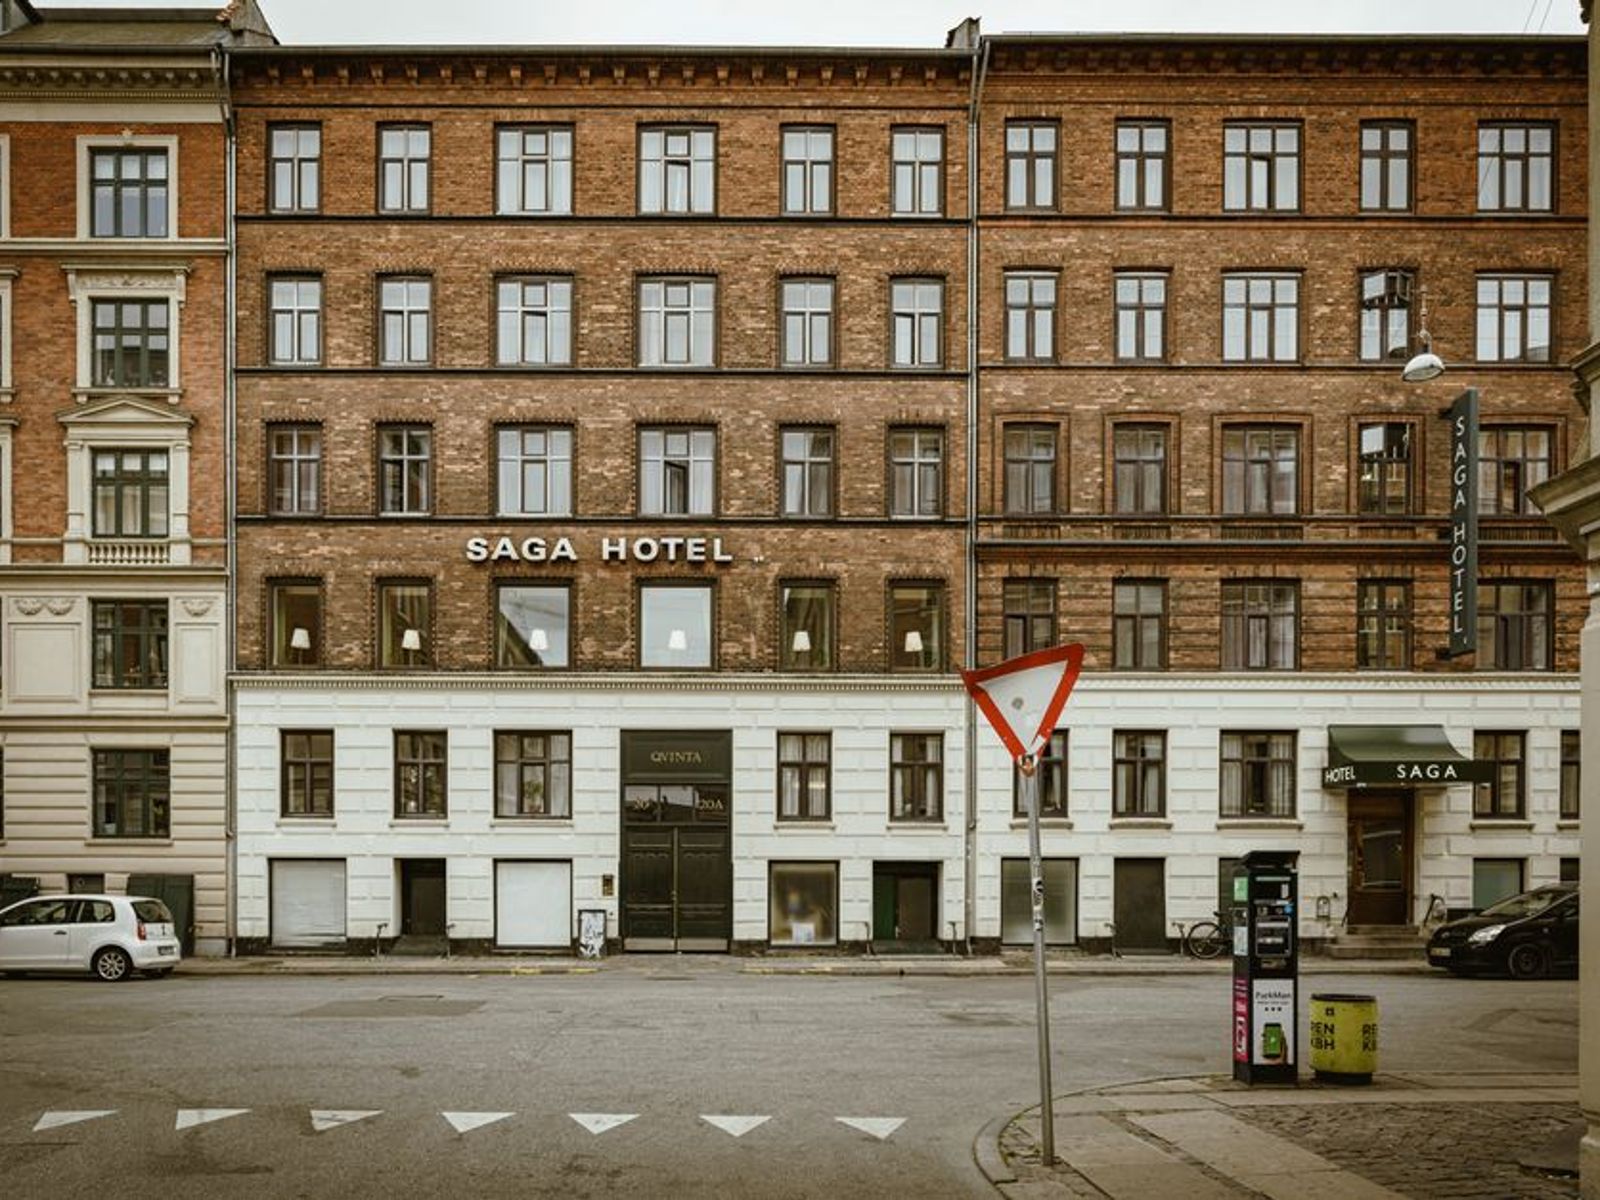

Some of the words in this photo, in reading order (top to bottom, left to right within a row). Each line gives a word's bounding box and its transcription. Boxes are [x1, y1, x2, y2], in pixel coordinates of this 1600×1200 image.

[1453, 415, 1467, 509] SAGA
[466, 537, 578, 562] SAGA
[601, 537, 734, 562] HOTEL
[1452, 527, 1467, 634] HOTEL
[650, 751, 702, 764] QVINTA
[1325, 766, 1356, 783] HOTEL
[1396, 764, 1458, 779] SAGA
